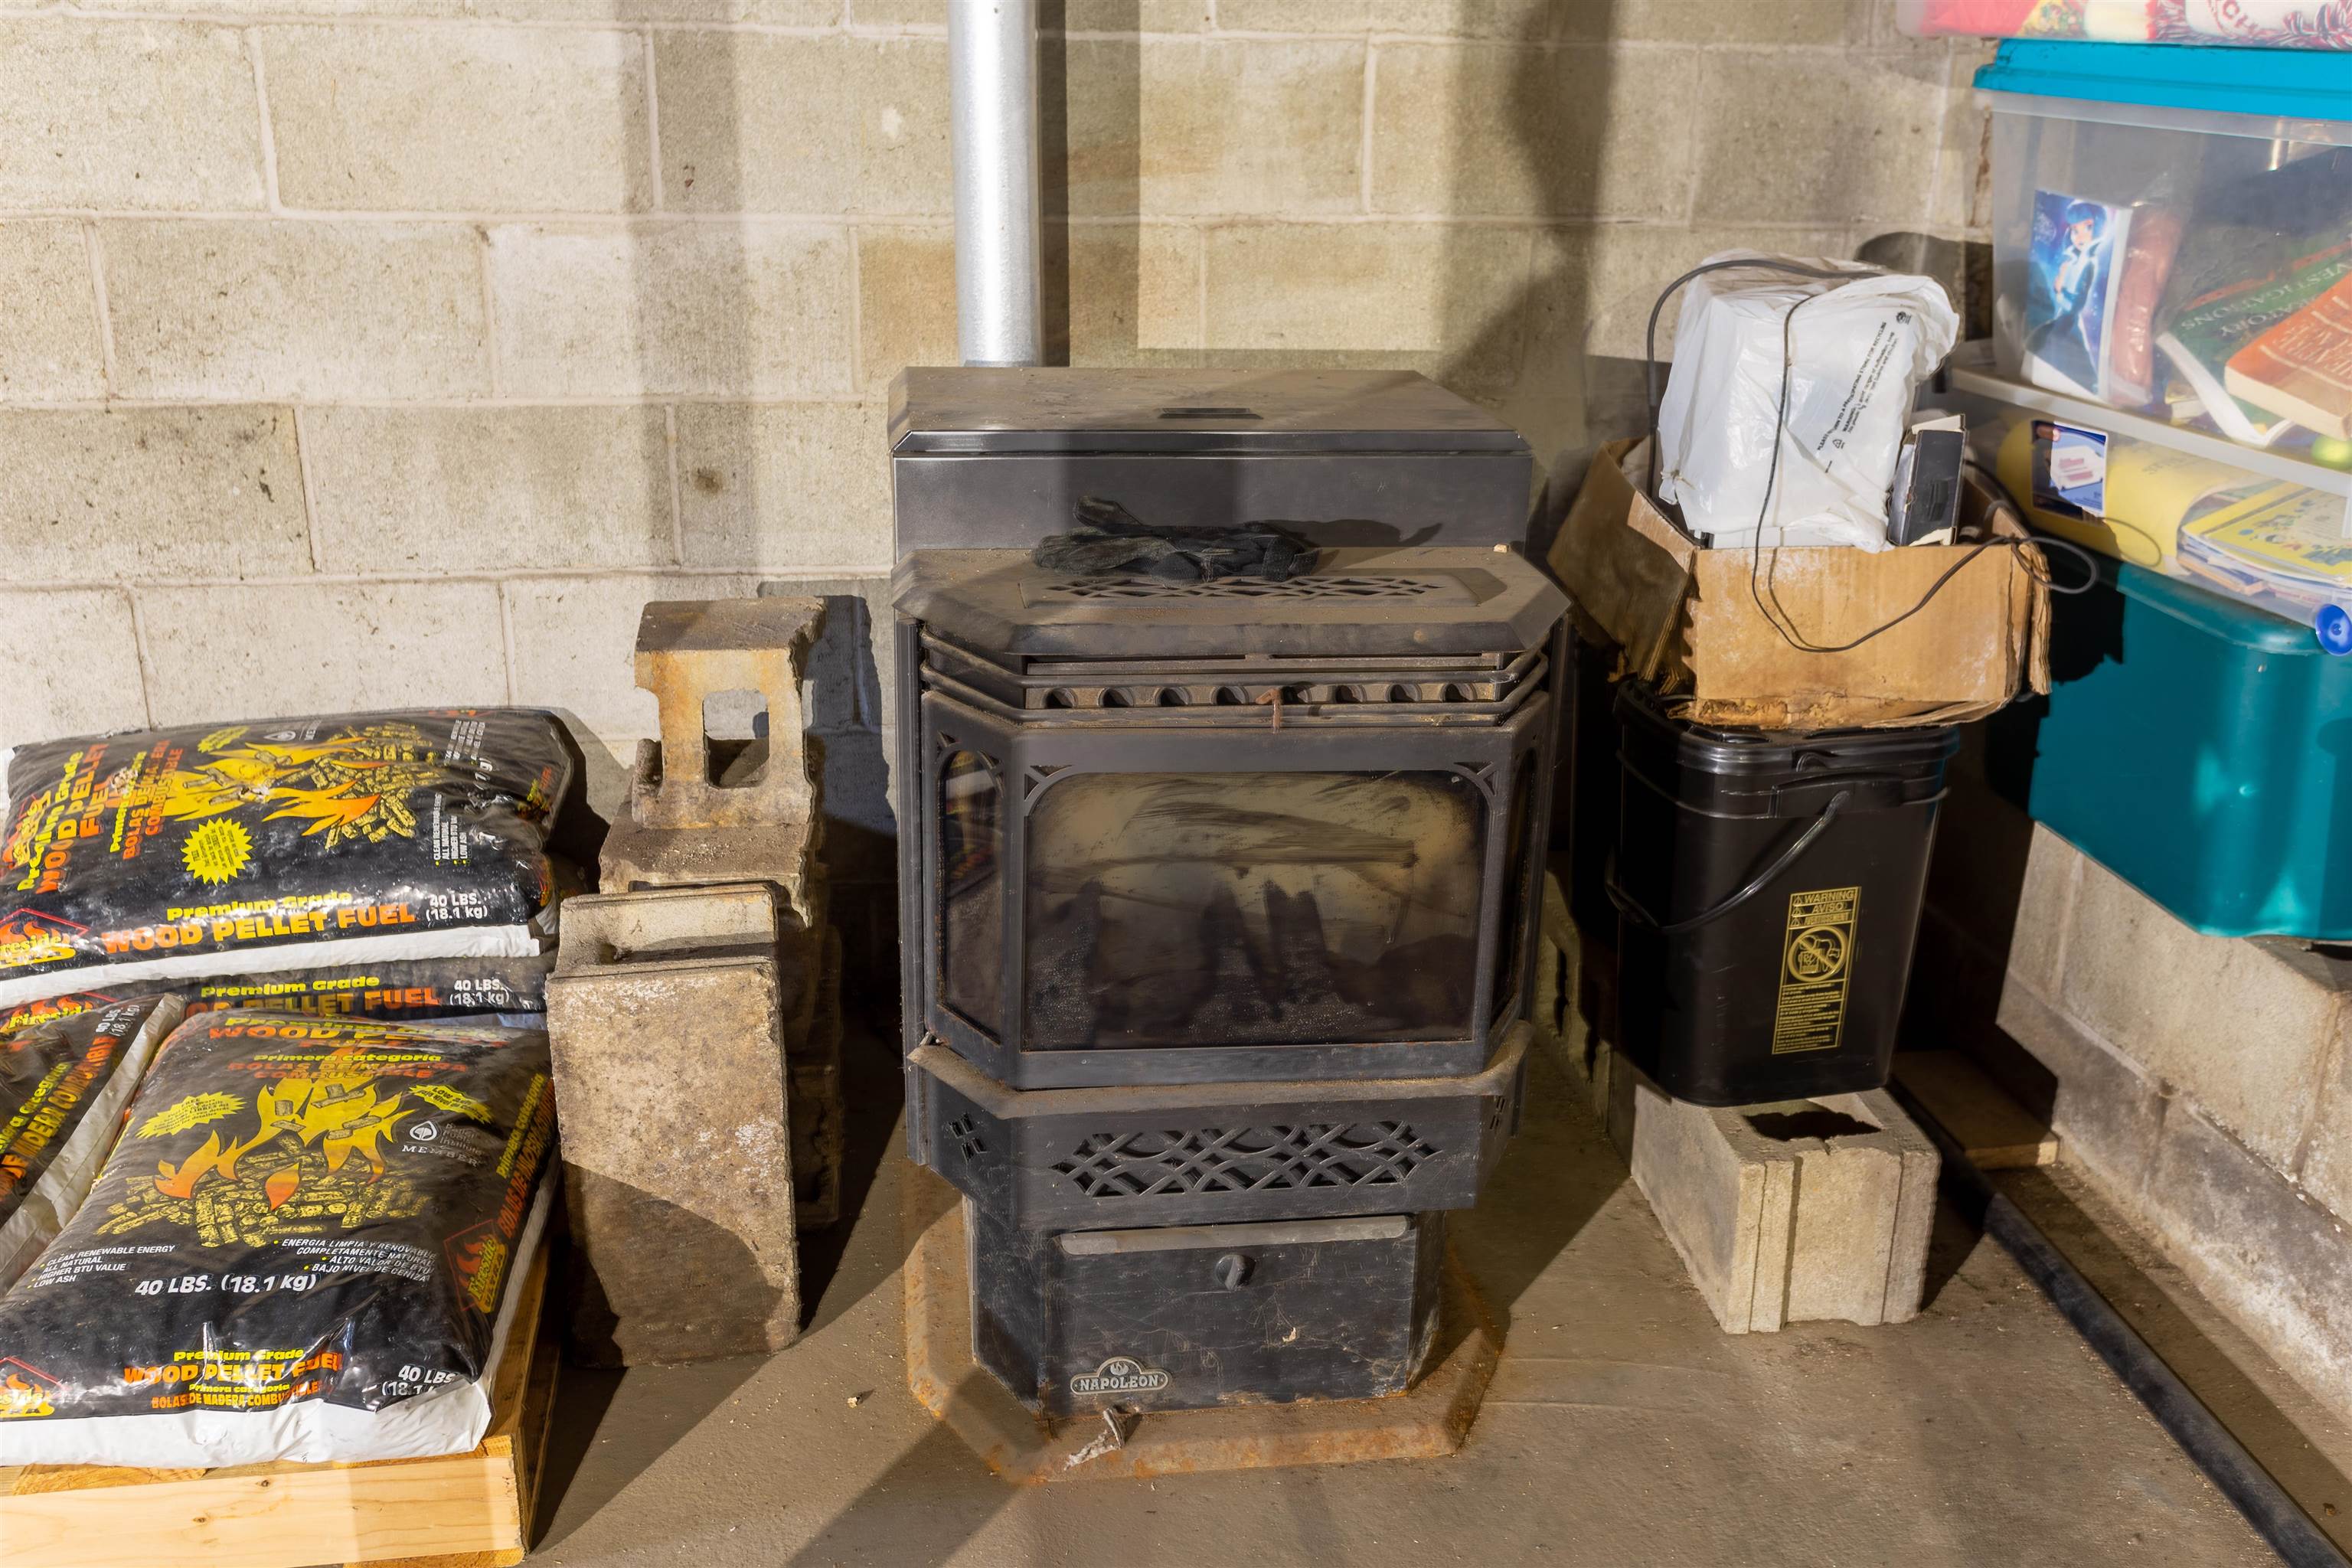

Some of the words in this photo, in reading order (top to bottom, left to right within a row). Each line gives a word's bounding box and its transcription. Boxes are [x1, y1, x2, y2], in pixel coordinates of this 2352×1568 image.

[140, 740, 172, 786] MAERA
[65, 743, 109, 815] PELLET
[134, 786, 151, 806] DE
[79, 774, 113, 838] FUEL
[17, 804, 65, 891] Premium
[54, 750, 83, 804] Grade
[122, 808, 144, 861] BOLAS
[459, 845, 468, 859] LOW
[166, 900, 279, 922] Premium
[282, 890, 353, 909] Grade
[430, 895, 447, 907] 40
[452, 893, 482, 906] LBS.
[1805, 890, 1854, 903] WARNING
[426, 907, 461, 922] (18.1
[464, 905, 488, 919] kg)
[1811, 902, 1845, 914] AVISO
[101, 924, 203, 954] WOOD
[211, 912, 331, 941] PELLET
[337, 903, 416, 929] FUEL
[0, 933, 62, 955] reside
[200, 983, 306, 998] Premium
[312, 975, 380, 991] Grade
[454, 979, 472, 991] 40
[364, 987, 440, 1011] FUEL
[449, 992, 483, 1006] (18.1
[488, 992, 510, 1005] kg)
[96, 1022, 111, 1033] 40
[209, 1026, 341, 1040] WOOD
[227, 1061, 312, 1071] BOLAS
[253, 1054, 337, 1062] Primera
[342, 1053, 443, 1063] categoria
[433, 1087, 453, 1099] Low
[496, 1129, 521, 1179] Primera
[515, 1073, 546, 1129] categoria
[402, 1145, 479, 1167] MEMBER
[46, 1253, 77, 1266] CLEAN
[77, 1246, 135, 1259] RENEWABLE
[136, 1245, 176, 1254] ENERGY
[282, 1239, 326, 1247] ENERGIA
[328, 1239, 365, 1248] LIMPIA
[378, 1242, 438, 1259] RENOVABLE
[296, 1247, 385, 1259] COMPLETAMENTE
[387, 1252, 435, 1266] NATURAL
[38, 1268, 74, 1281] HIGHER
[74, 1265, 95, 1274] BTU
[96, 1263, 127, 1272] VALUE
[42, 1263, 60, 1274] ALL
[60, 1256, 103, 1269] NATURAL
[312, 1263, 340, 1273] BAJO
[342, 1265, 373, 1273] NIVEL
[390, 1267, 430, 1282] CENIZA
[329, 1256, 356, 1264] ALTO
[359, 1257, 391, 1266] VALOR
[395, 1260, 411, 1269] DE
[411, 1264, 433, 1275] BTU
[468, 1238, 497, 1300] Fireside
[33, 1278, 56, 1289] LOW
[56, 1275, 77, 1284] ASH
[135, 1279, 164, 1296] 40
[168, 1275, 212, 1294] LBS.
[220, 1275, 276, 1295] (18.1
[279, 1274, 317, 1292] kg)
[253, 1349, 305, 1361] Grade
[123, 1364, 199, 1385] WOOD
[204, 1364, 286, 1383] PELLET
[292, 1352, 340, 1377] FUEL
[398, 1365, 422, 1382] 40
[189, 1383, 232, 1393] Primera
[1080, 1374, 1159, 1391] NAPOLEON
[152, 1393, 187, 1410] BOLAS
[189, 1393, 202, 1406] DE
[203, 1393, 244, 1408] MADERA
